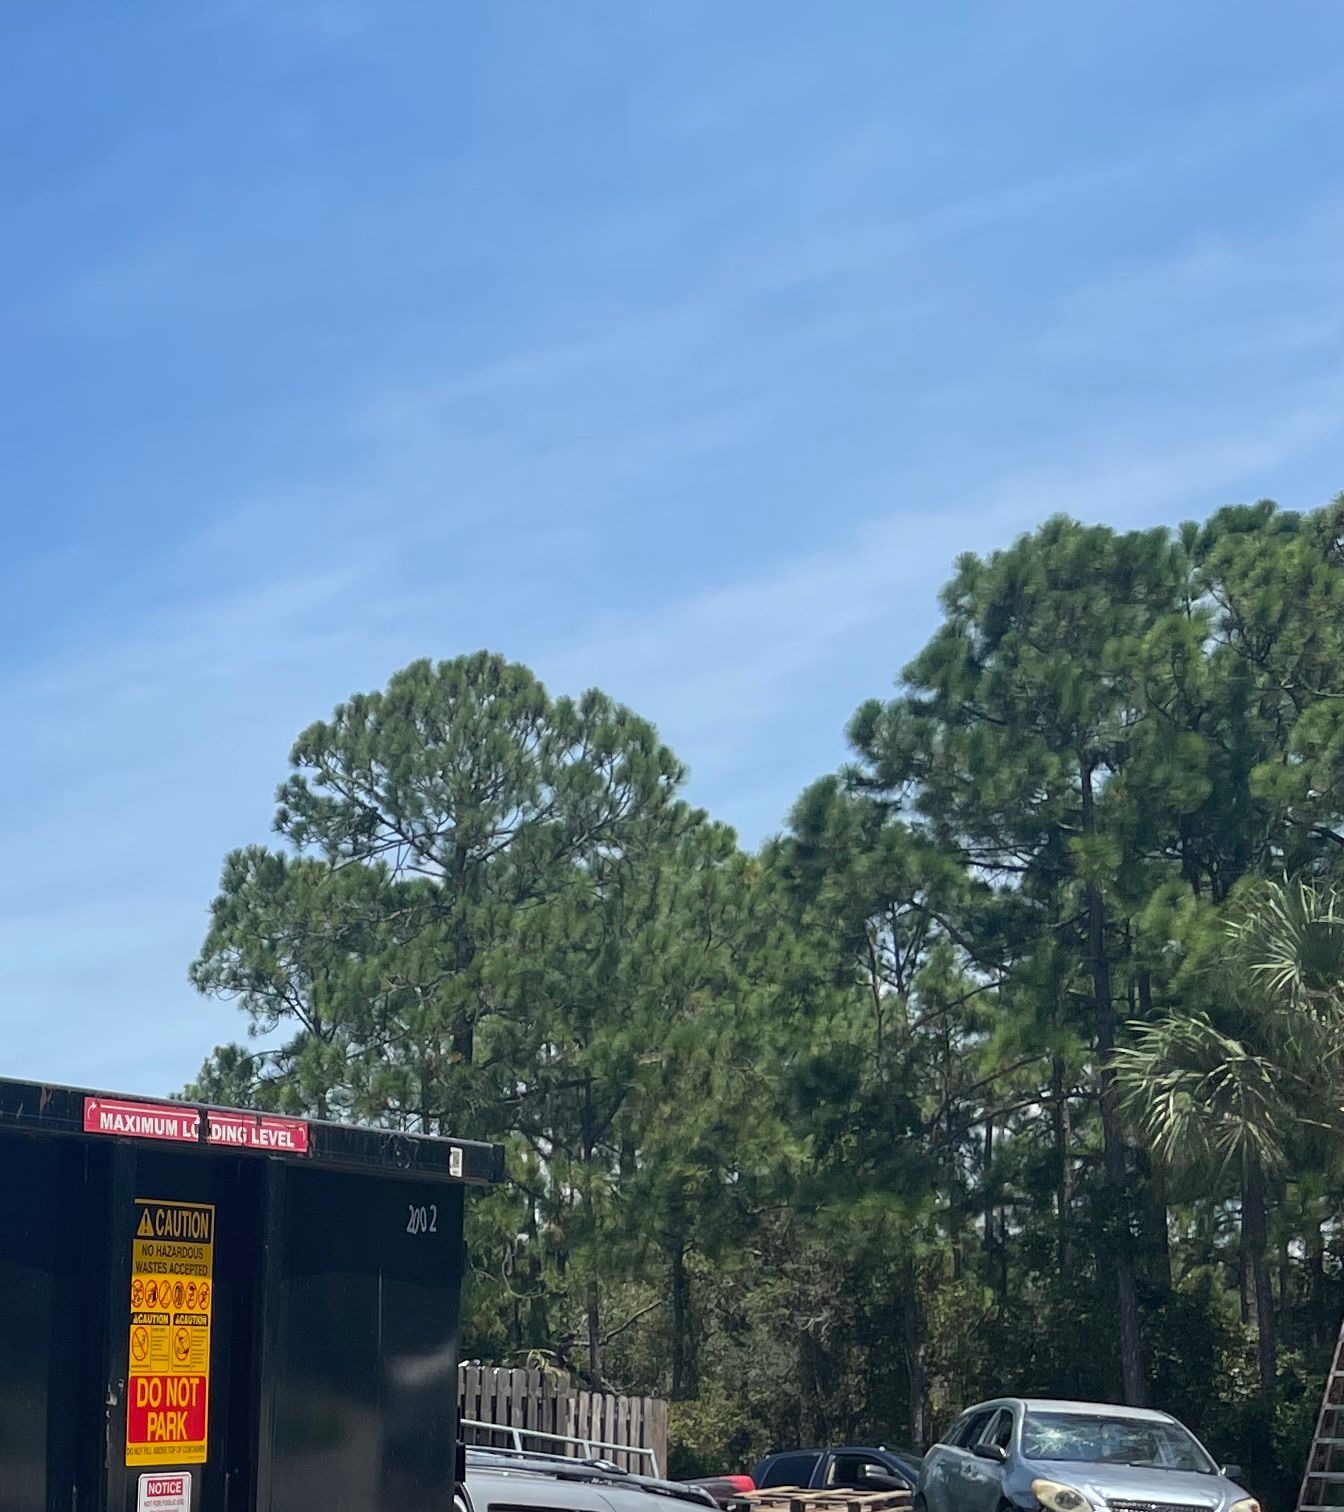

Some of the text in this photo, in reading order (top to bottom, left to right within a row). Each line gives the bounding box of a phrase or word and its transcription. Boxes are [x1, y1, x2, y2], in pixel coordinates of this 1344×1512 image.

[100, 1112, 295, 1148] MAXIMUM LODING LEVEL
[155, 1208, 210, 1239] CAUTION
[142, 1244, 204, 1260] NO HAZARDOUS
[135, 1261, 208, 1276] WASTES ACCEPTED
[138, 1313, 169, 1325] CAUTION
[136, 1376, 200, 1408] DO NOT
[147, 1411, 188, 1441] PARK
[148, 1481, 182, 1495] NOTICE
